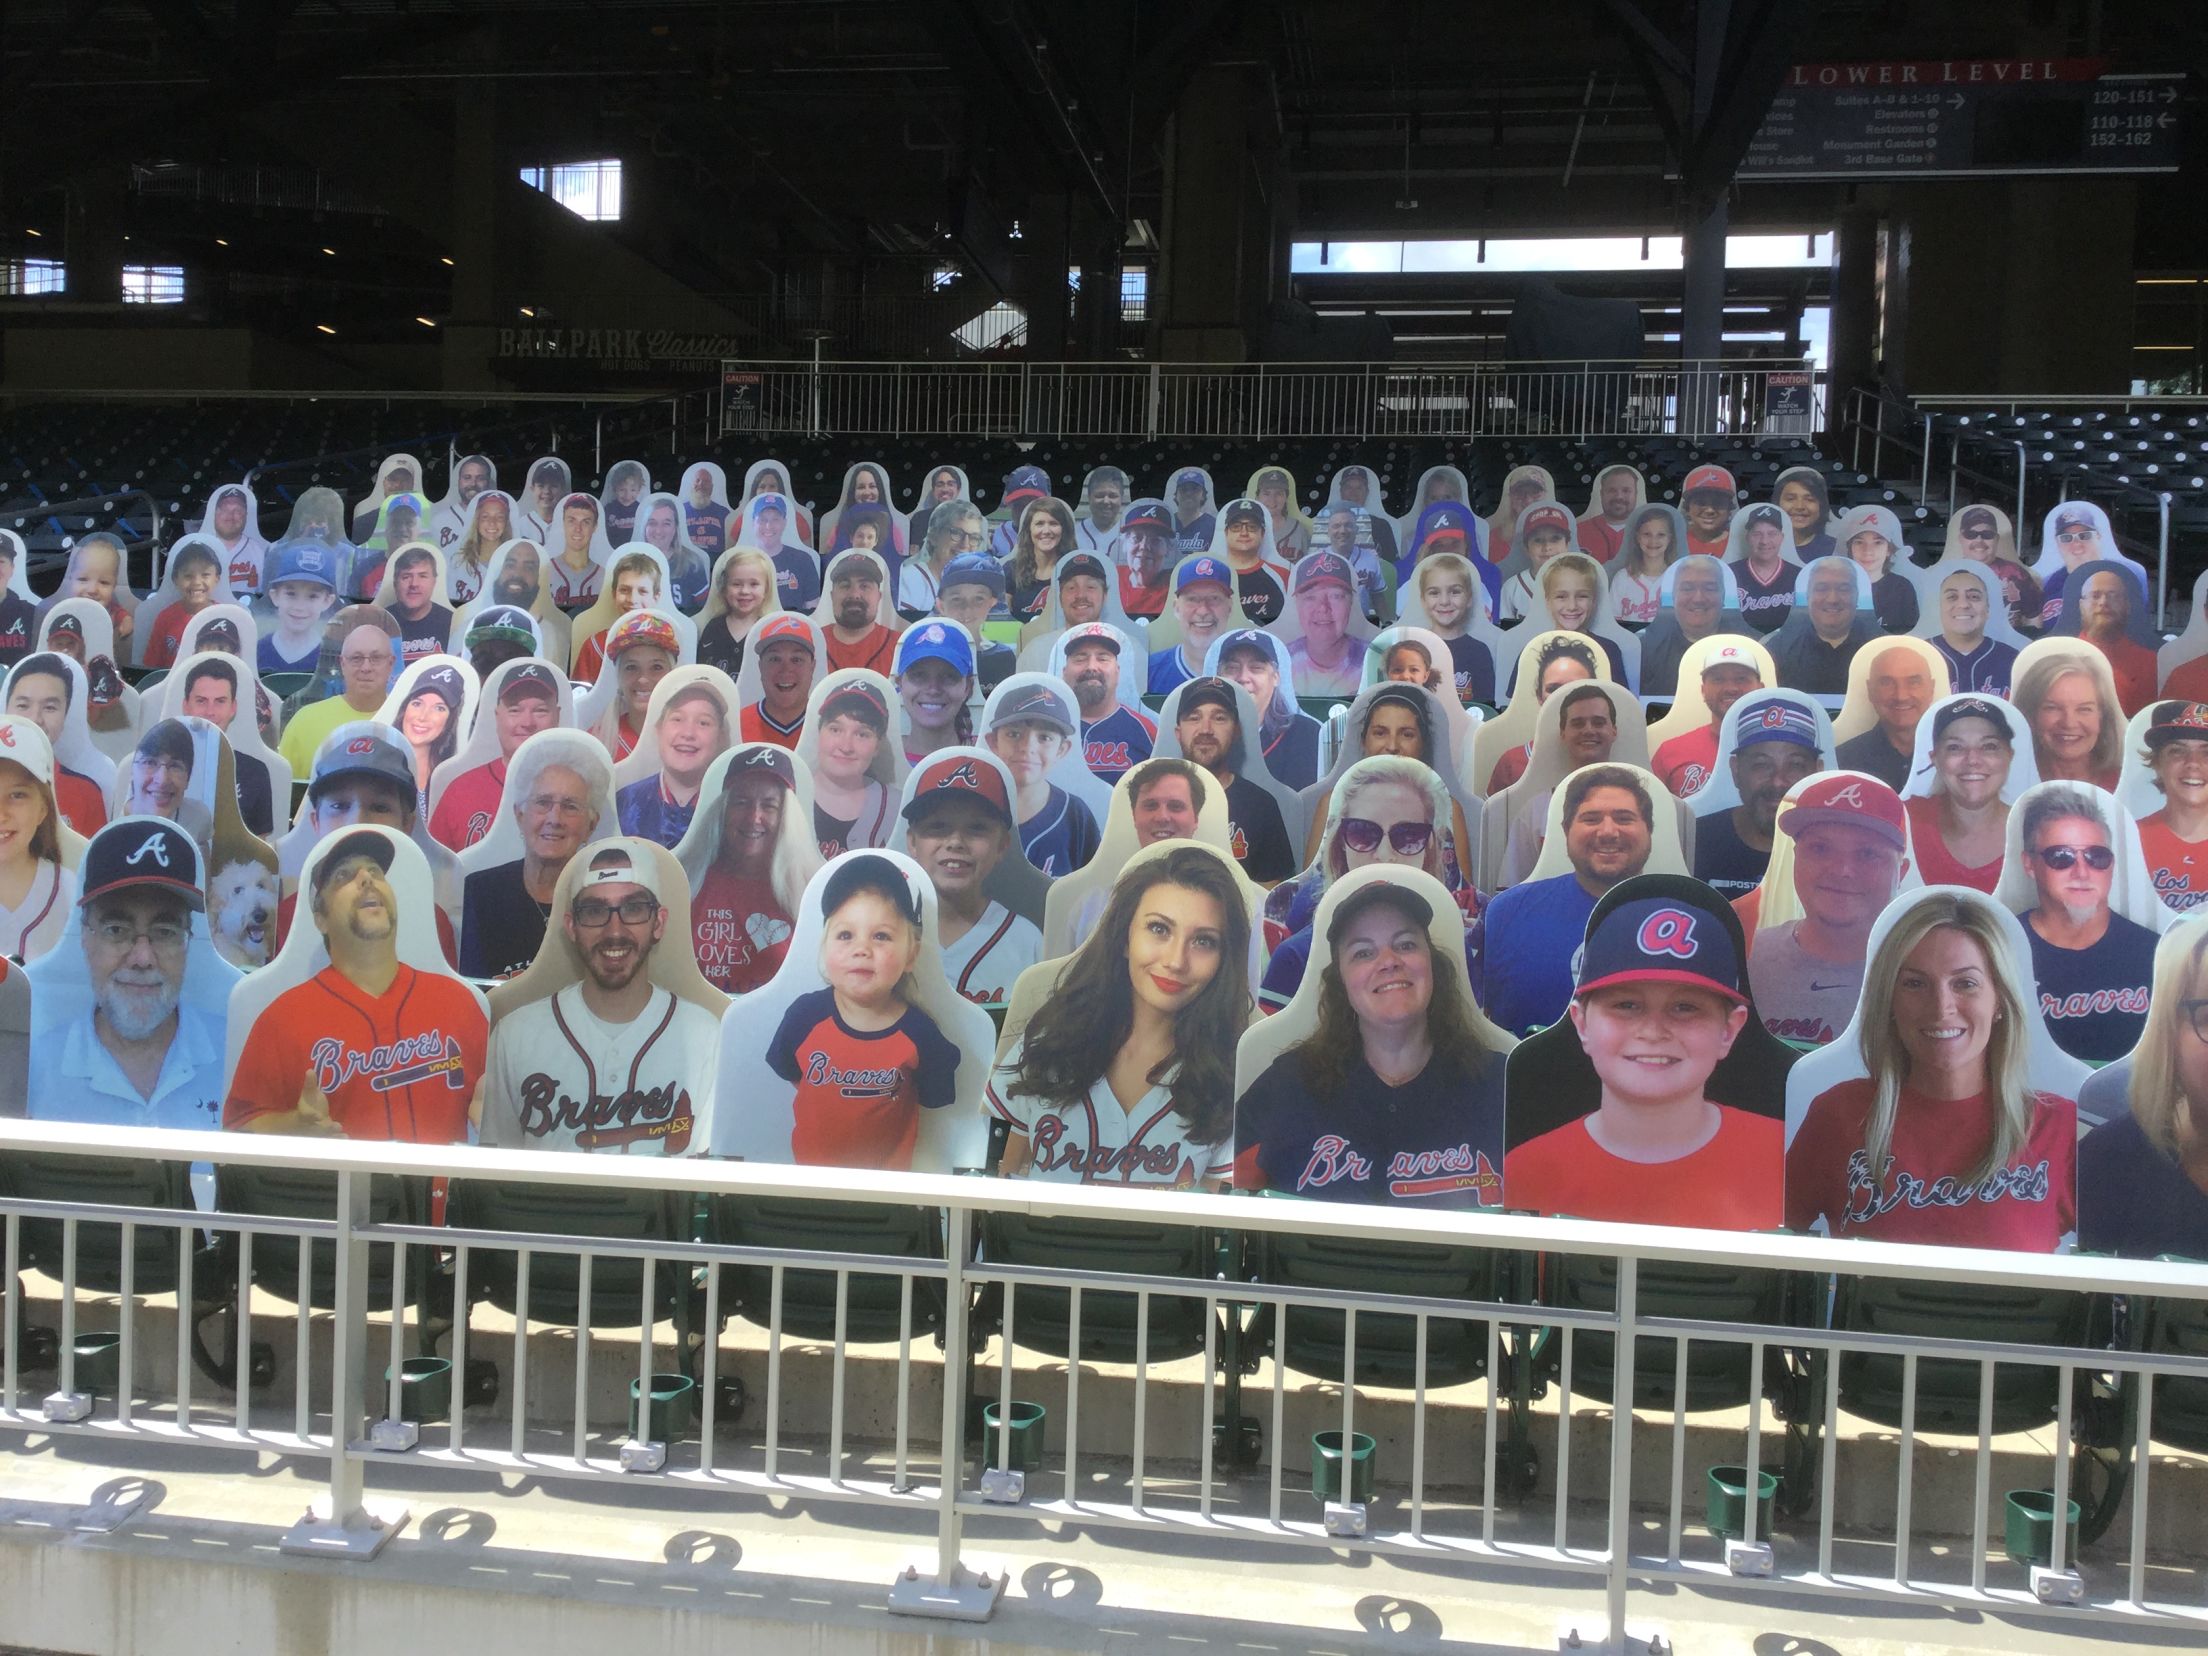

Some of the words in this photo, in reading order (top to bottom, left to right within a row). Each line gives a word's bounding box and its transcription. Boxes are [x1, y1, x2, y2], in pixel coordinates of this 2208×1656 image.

[1793, 65, 1919, 86] LOWER
[1943, 62, 2058, 83] LEVEL
[2093, 90, 2154, 104] 120-151
[1874, 109, 1926, 120] Elevators
[1865, 123, 1925, 135] Restrooms
[2091, 116, 2153, 129] 110-118
[1822, 139, 1881, 150] Monument
[1884, 138, 1925, 150] Garden
[2089, 132, 2153, 146] 152-162
[1844, 153, 1863, 165] 3rd
[1865, 153, 1893, 165] Base
[1896, 152, 1923, 164] Gate
[498, 327, 642, 359] BALLPARK
[646, 329, 739, 359] Classics
[725, 374, 760, 384] CAUTION
[1768, 375, 1809, 385] CAUTION
[2152, 868, 2190, 890] Los
[706, 909, 734, 921] THIS
[697, 921, 743, 943] GIRL
[694, 944, 753, 967] OVES
[705, 965, 733, 979] HER
[310, 1028, 443, 1095] Braves
[807, 1049, 899, 1088] Braves
[519, 1072, 679, 1138] Braves
[1031, 1113, 1182, 1174] Braves
